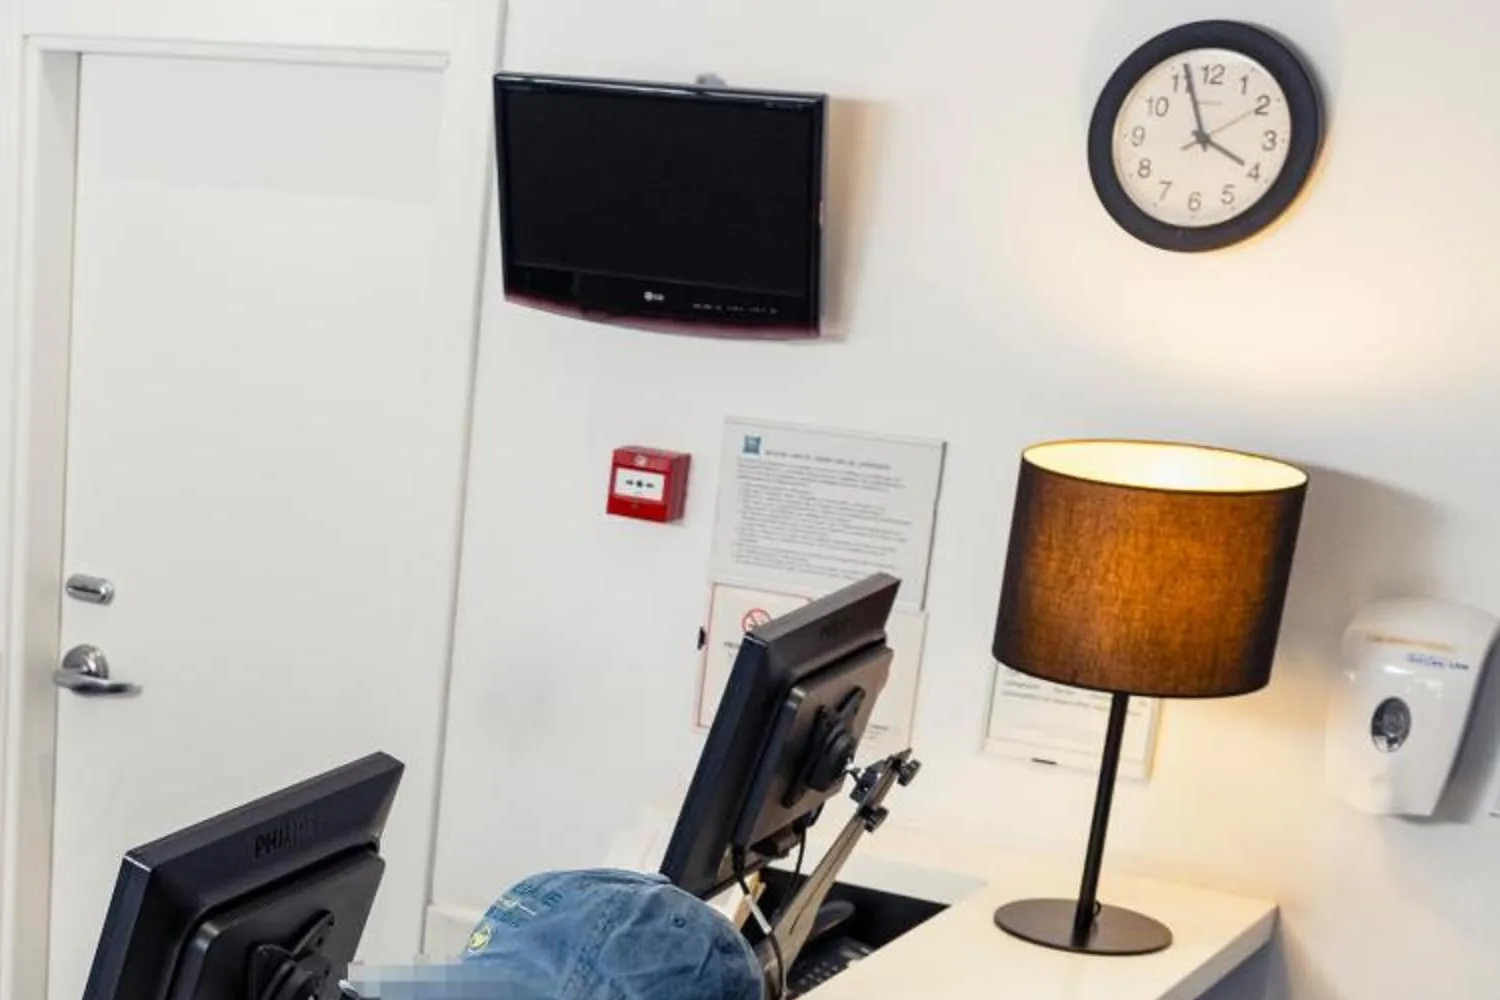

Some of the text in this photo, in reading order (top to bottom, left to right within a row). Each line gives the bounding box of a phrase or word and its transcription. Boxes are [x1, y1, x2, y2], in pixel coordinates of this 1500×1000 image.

[1202, 64, 1226, 85] 12
[1240, 75, 1249, 95] 1
[1147, 96, 1169, 117] 10
[1253, 95, 1270, 116] 2
[1131, 127, 1145, 147] 9
[1262, 130, 1277, 152] 3
[1137, 159, 1151, 179] 8
[1246, 162, 1261, 182] 4
[1159, 181, 1173, 201] 7
[1221, 184, 1235, 205] 5
[1187, 192, 1202, 211] 6
